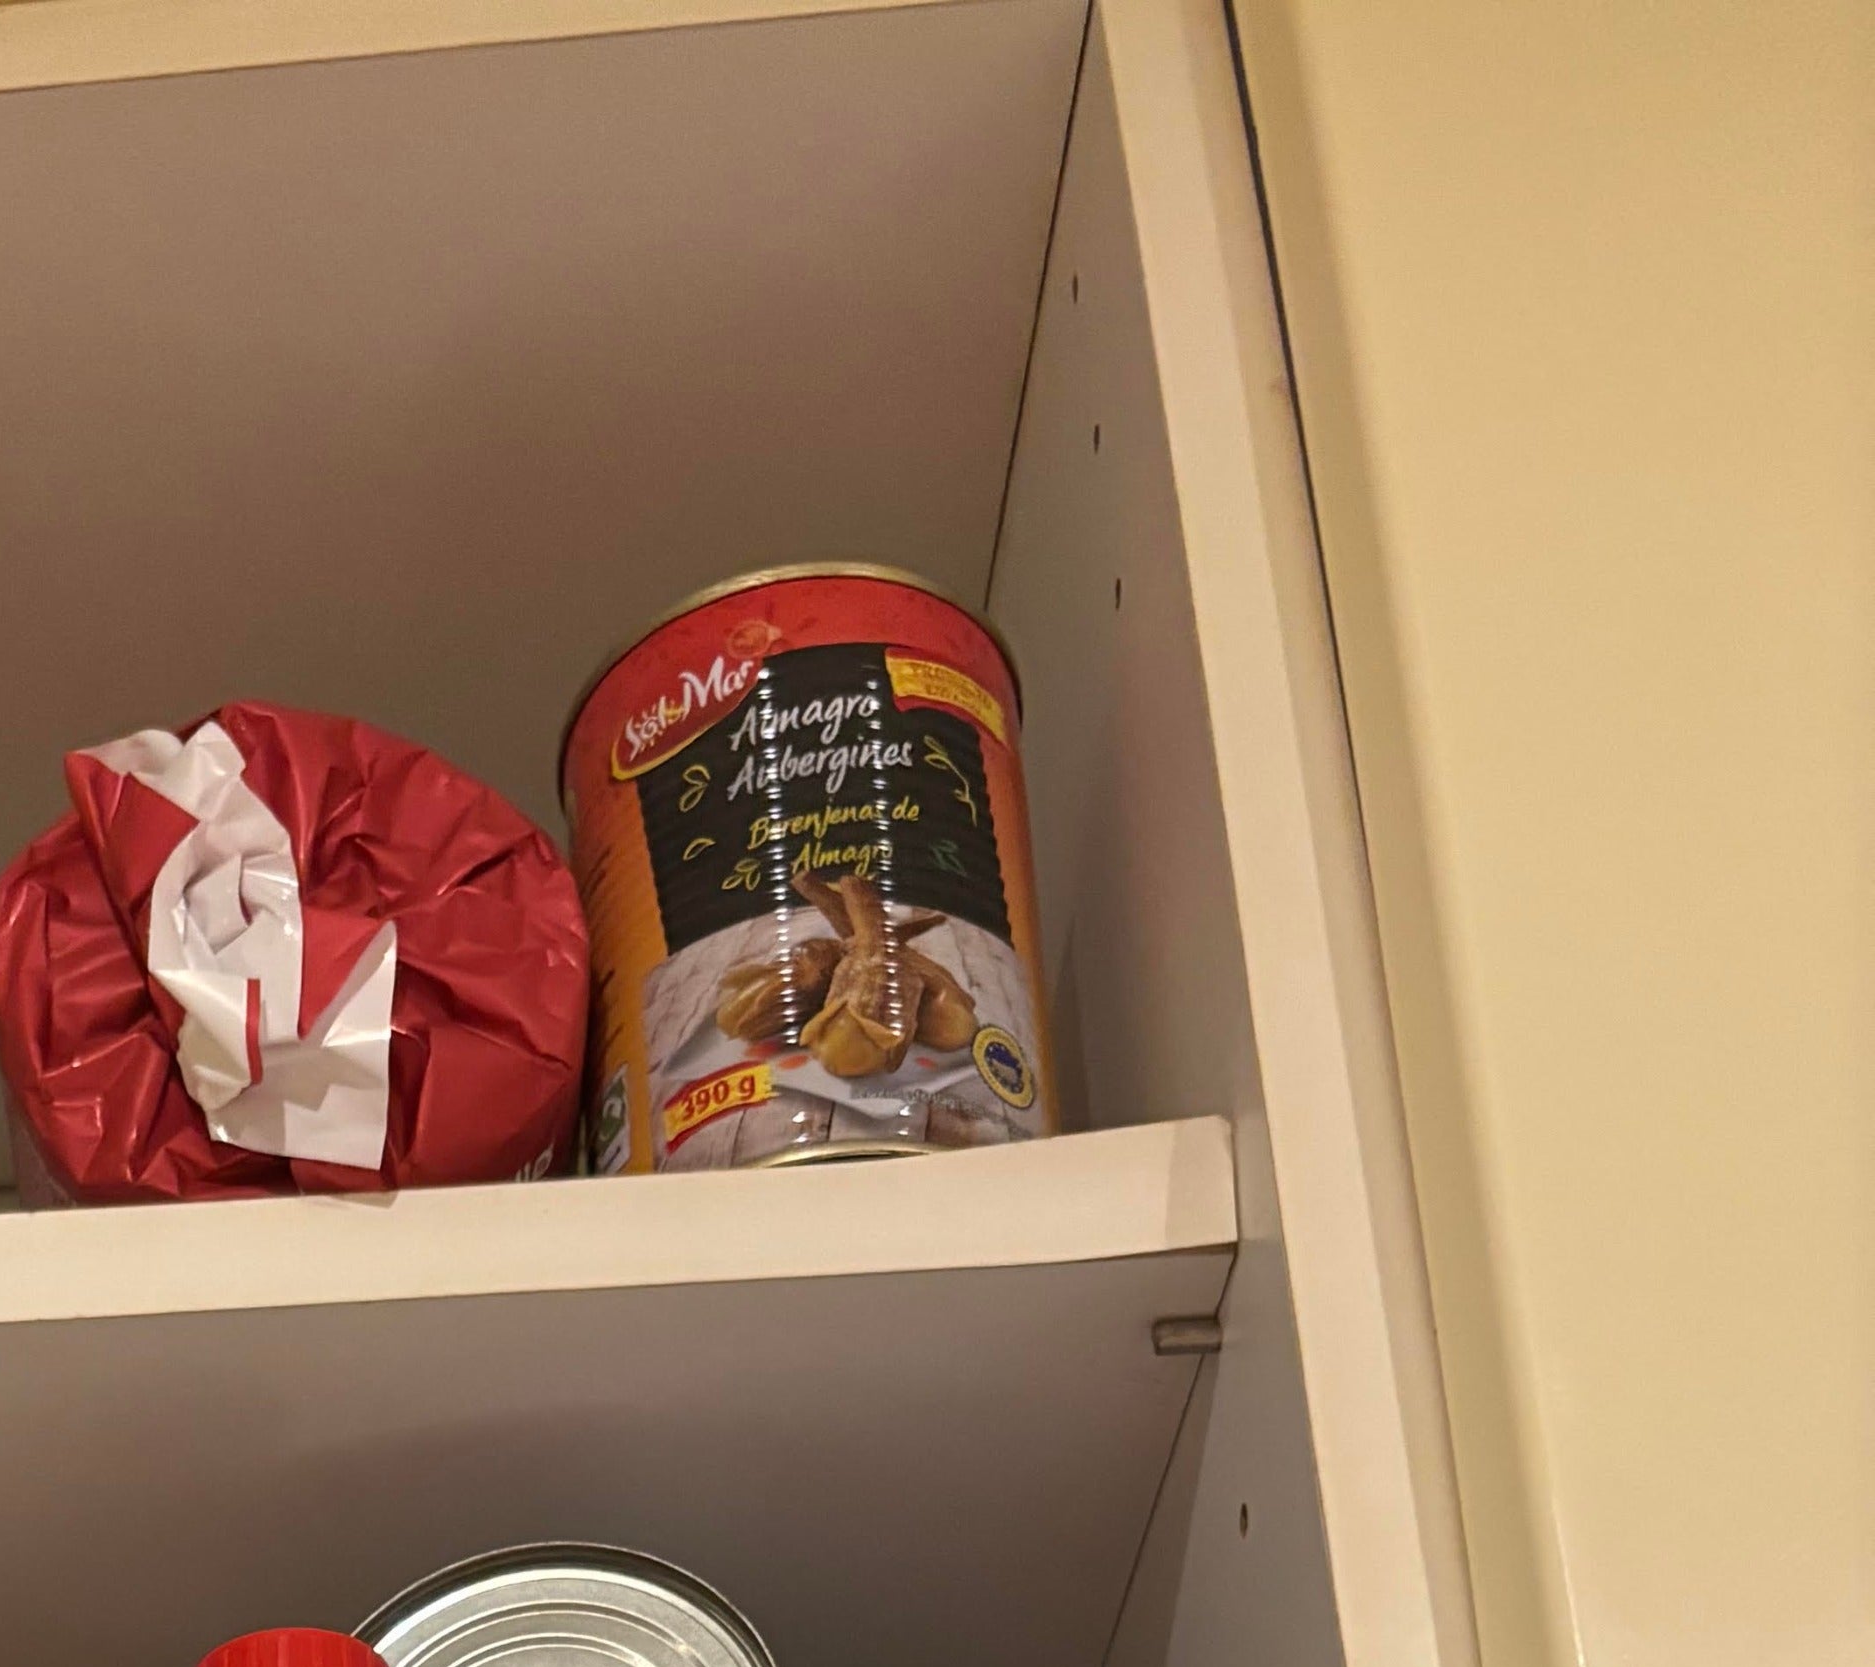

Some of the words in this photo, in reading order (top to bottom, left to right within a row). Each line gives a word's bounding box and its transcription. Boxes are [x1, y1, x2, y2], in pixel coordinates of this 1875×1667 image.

[730, 690, 877, 750] Almagro
[727, 740, 914, 800] Aubergines
[893, 801, 920, 824] de
[681, 1082, 731, 1120] 390
[739, 1076, 756, 1102] g
